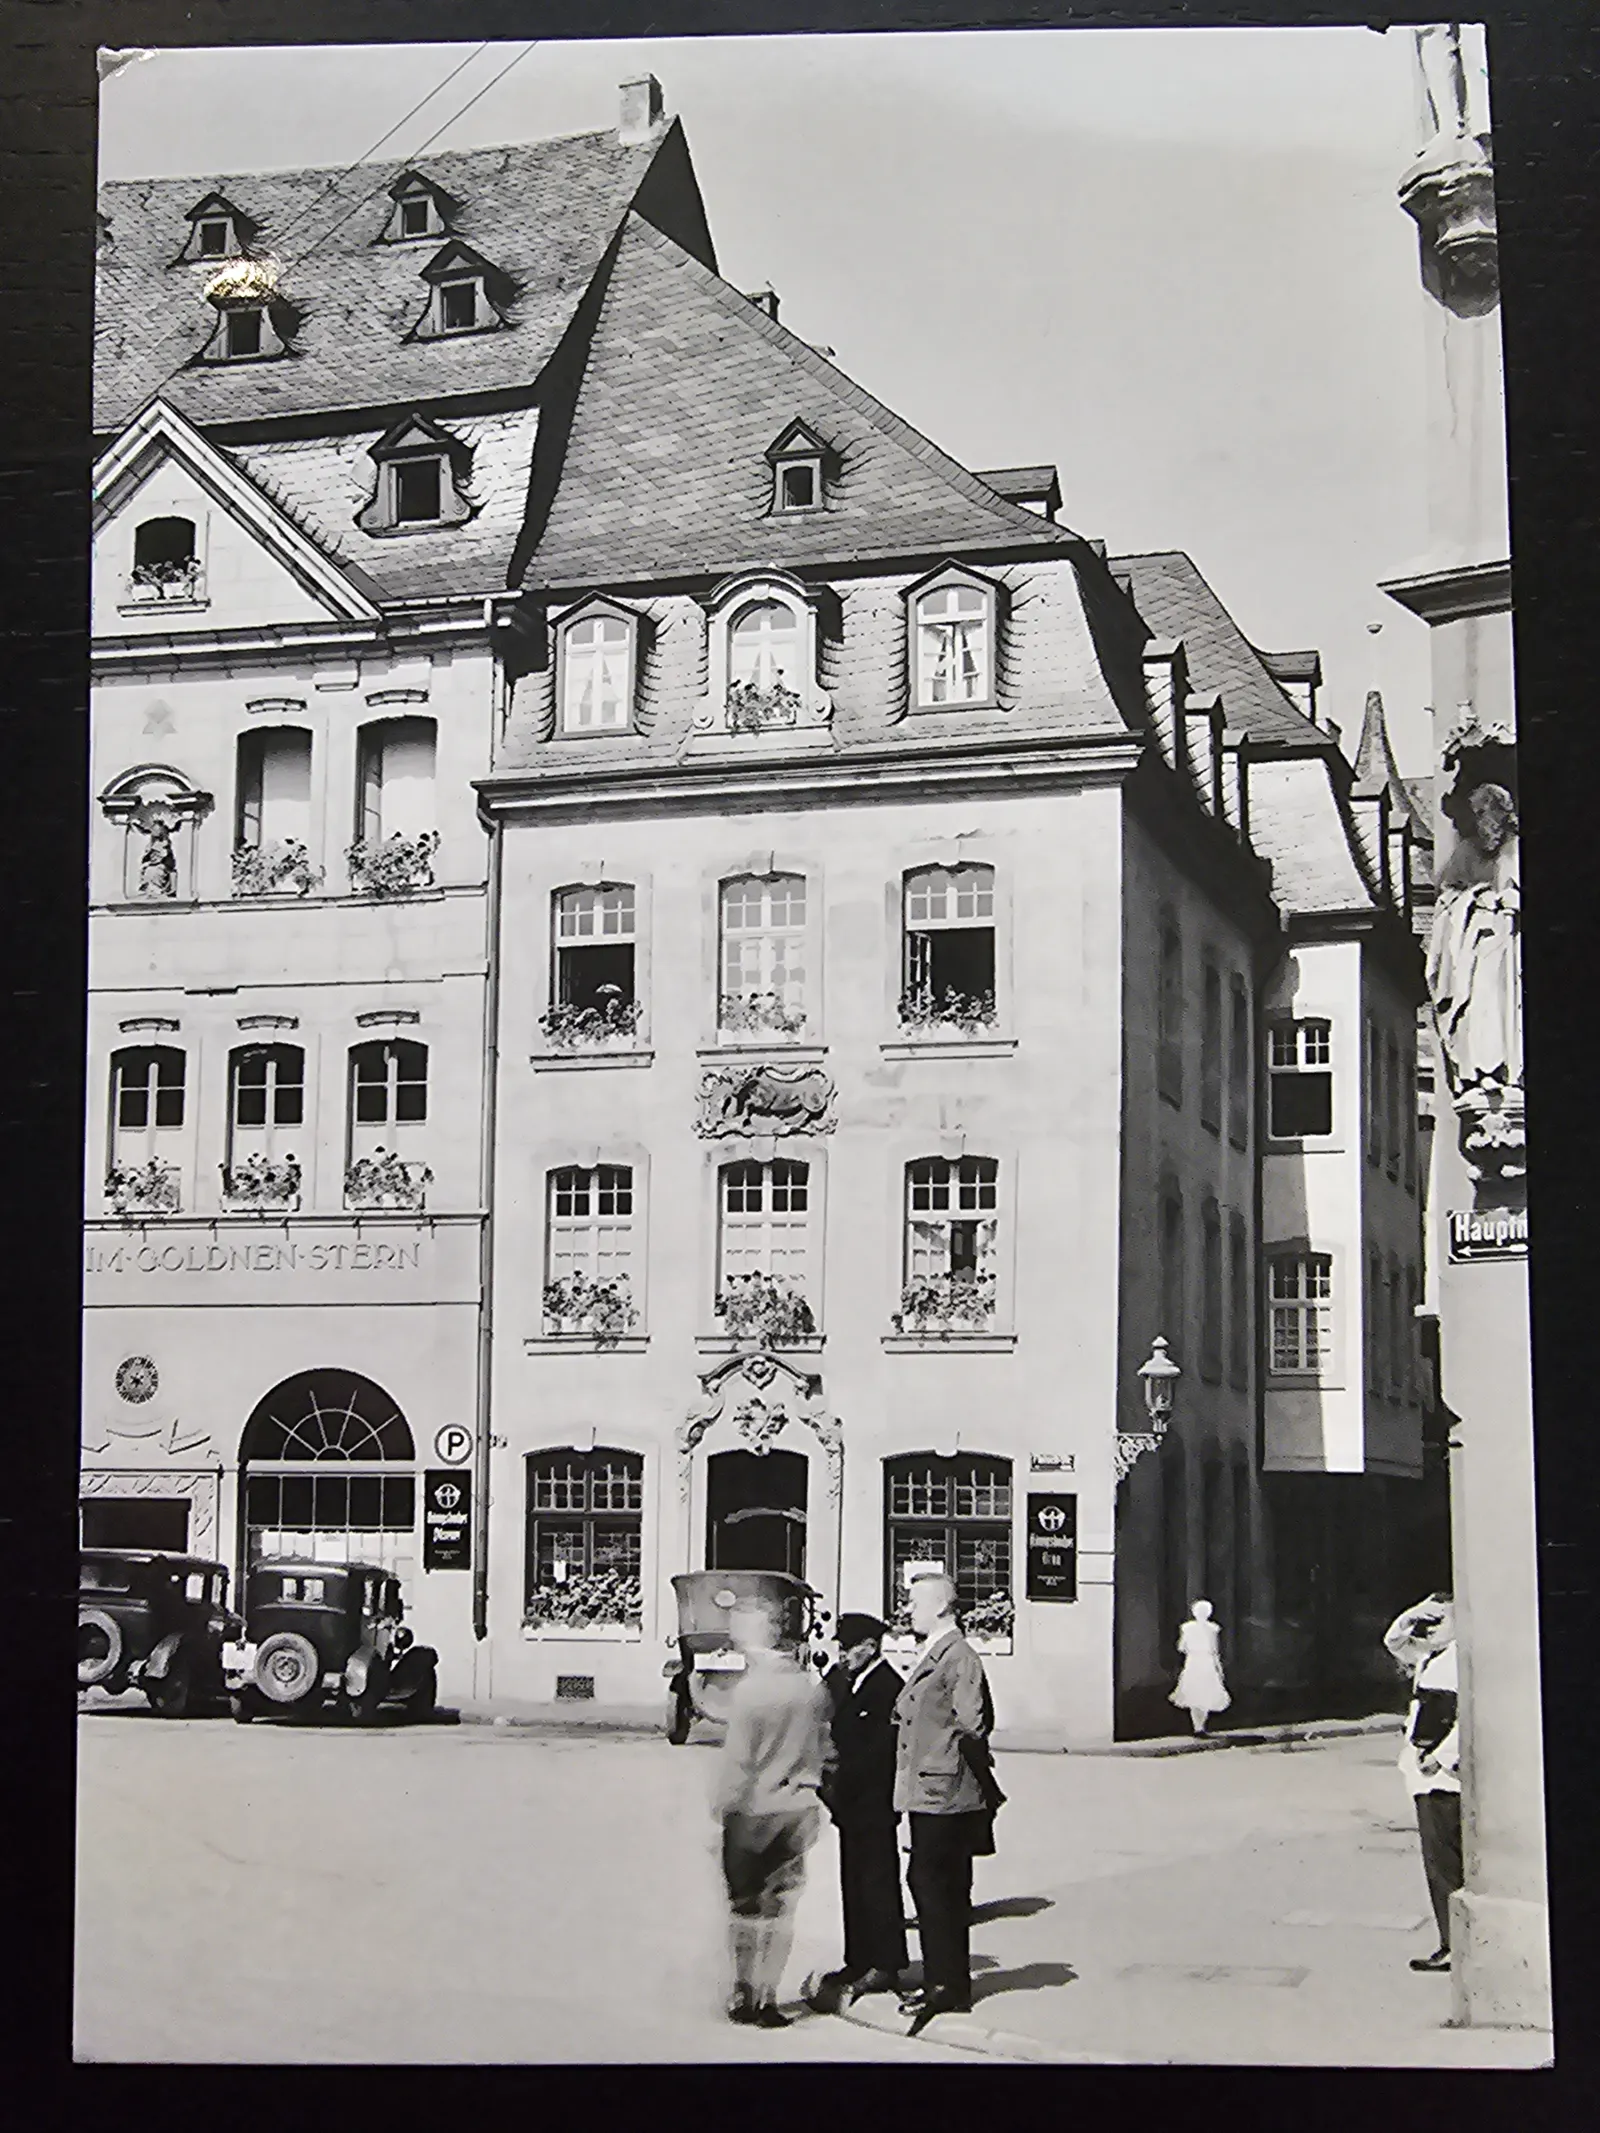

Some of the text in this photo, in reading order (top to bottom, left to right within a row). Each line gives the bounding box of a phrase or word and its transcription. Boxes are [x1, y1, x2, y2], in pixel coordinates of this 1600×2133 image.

[137, 1245, 297, 1272] GOLDNEN
[309, 1243, 420, 1270] STERN
[447, 1431, 465, 1457] P
